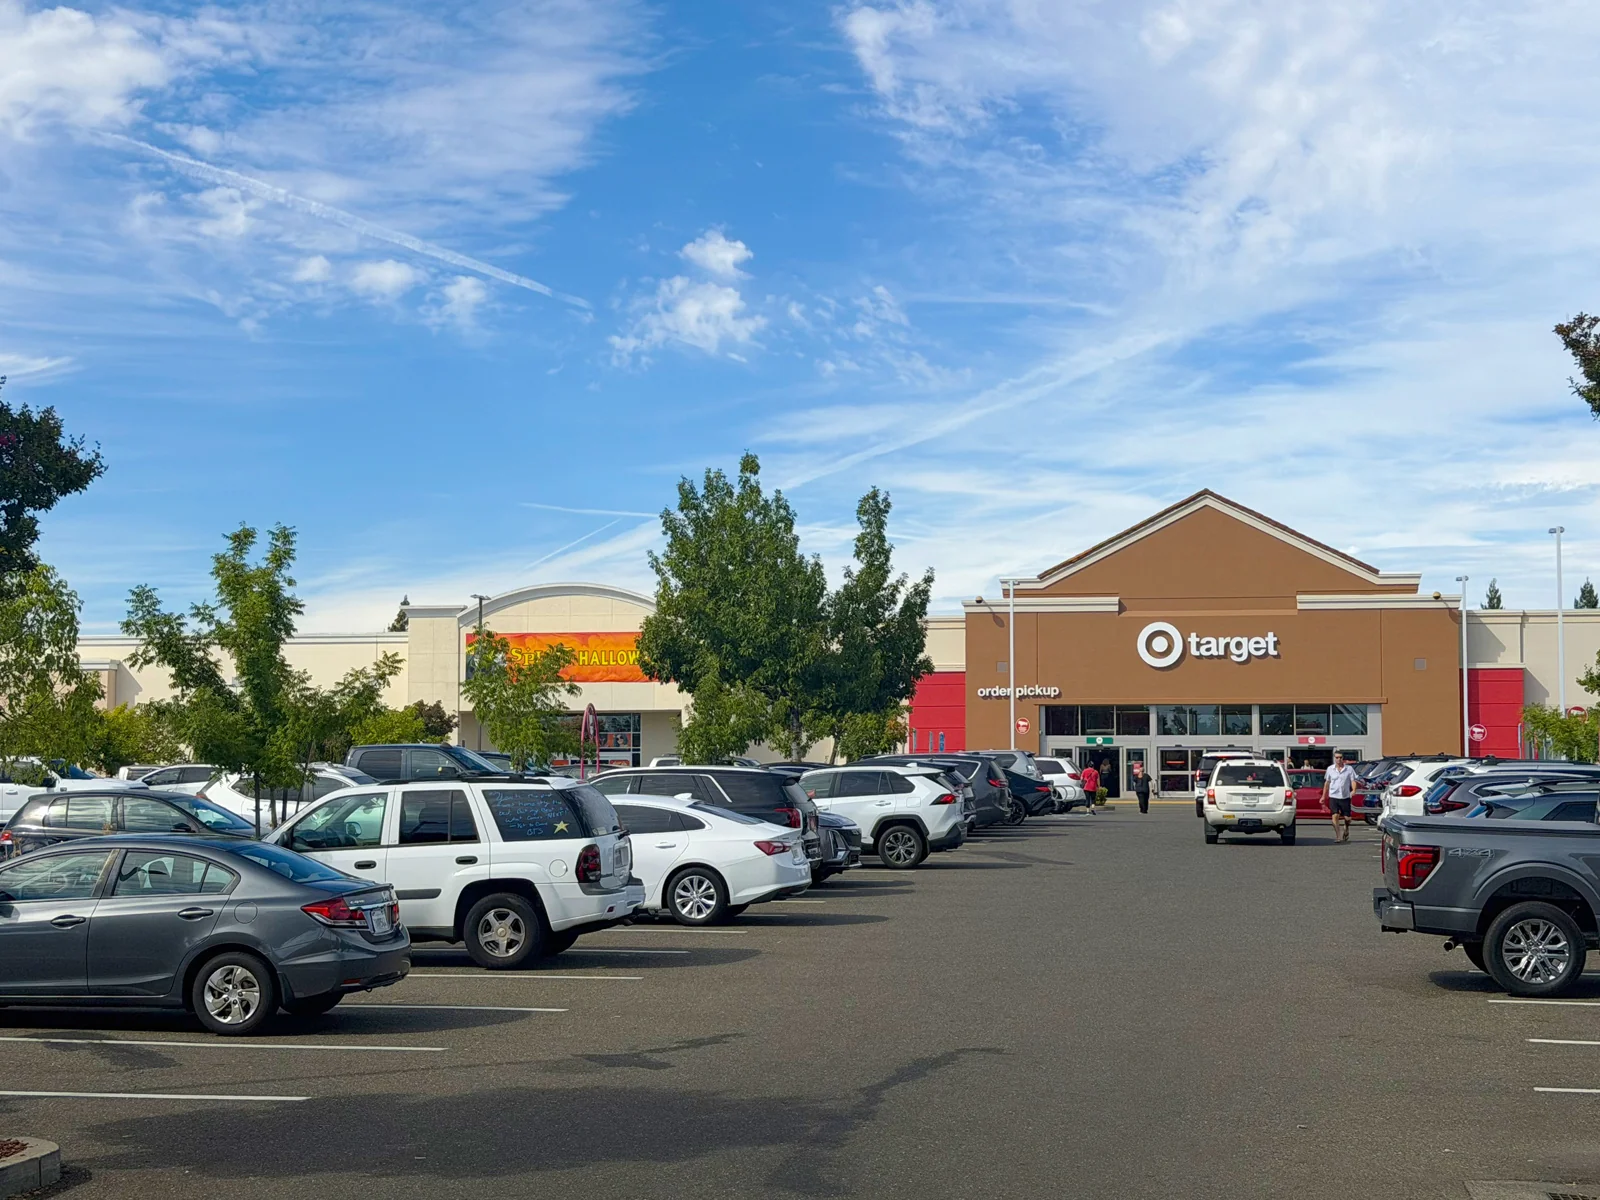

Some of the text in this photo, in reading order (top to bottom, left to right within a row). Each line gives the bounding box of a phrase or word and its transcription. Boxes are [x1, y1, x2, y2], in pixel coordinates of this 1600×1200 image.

[1188, 631, 1278, 662] target
[578, 650, 640, 666] HALLOW
[977, 685, 1059, 698] order pickup
